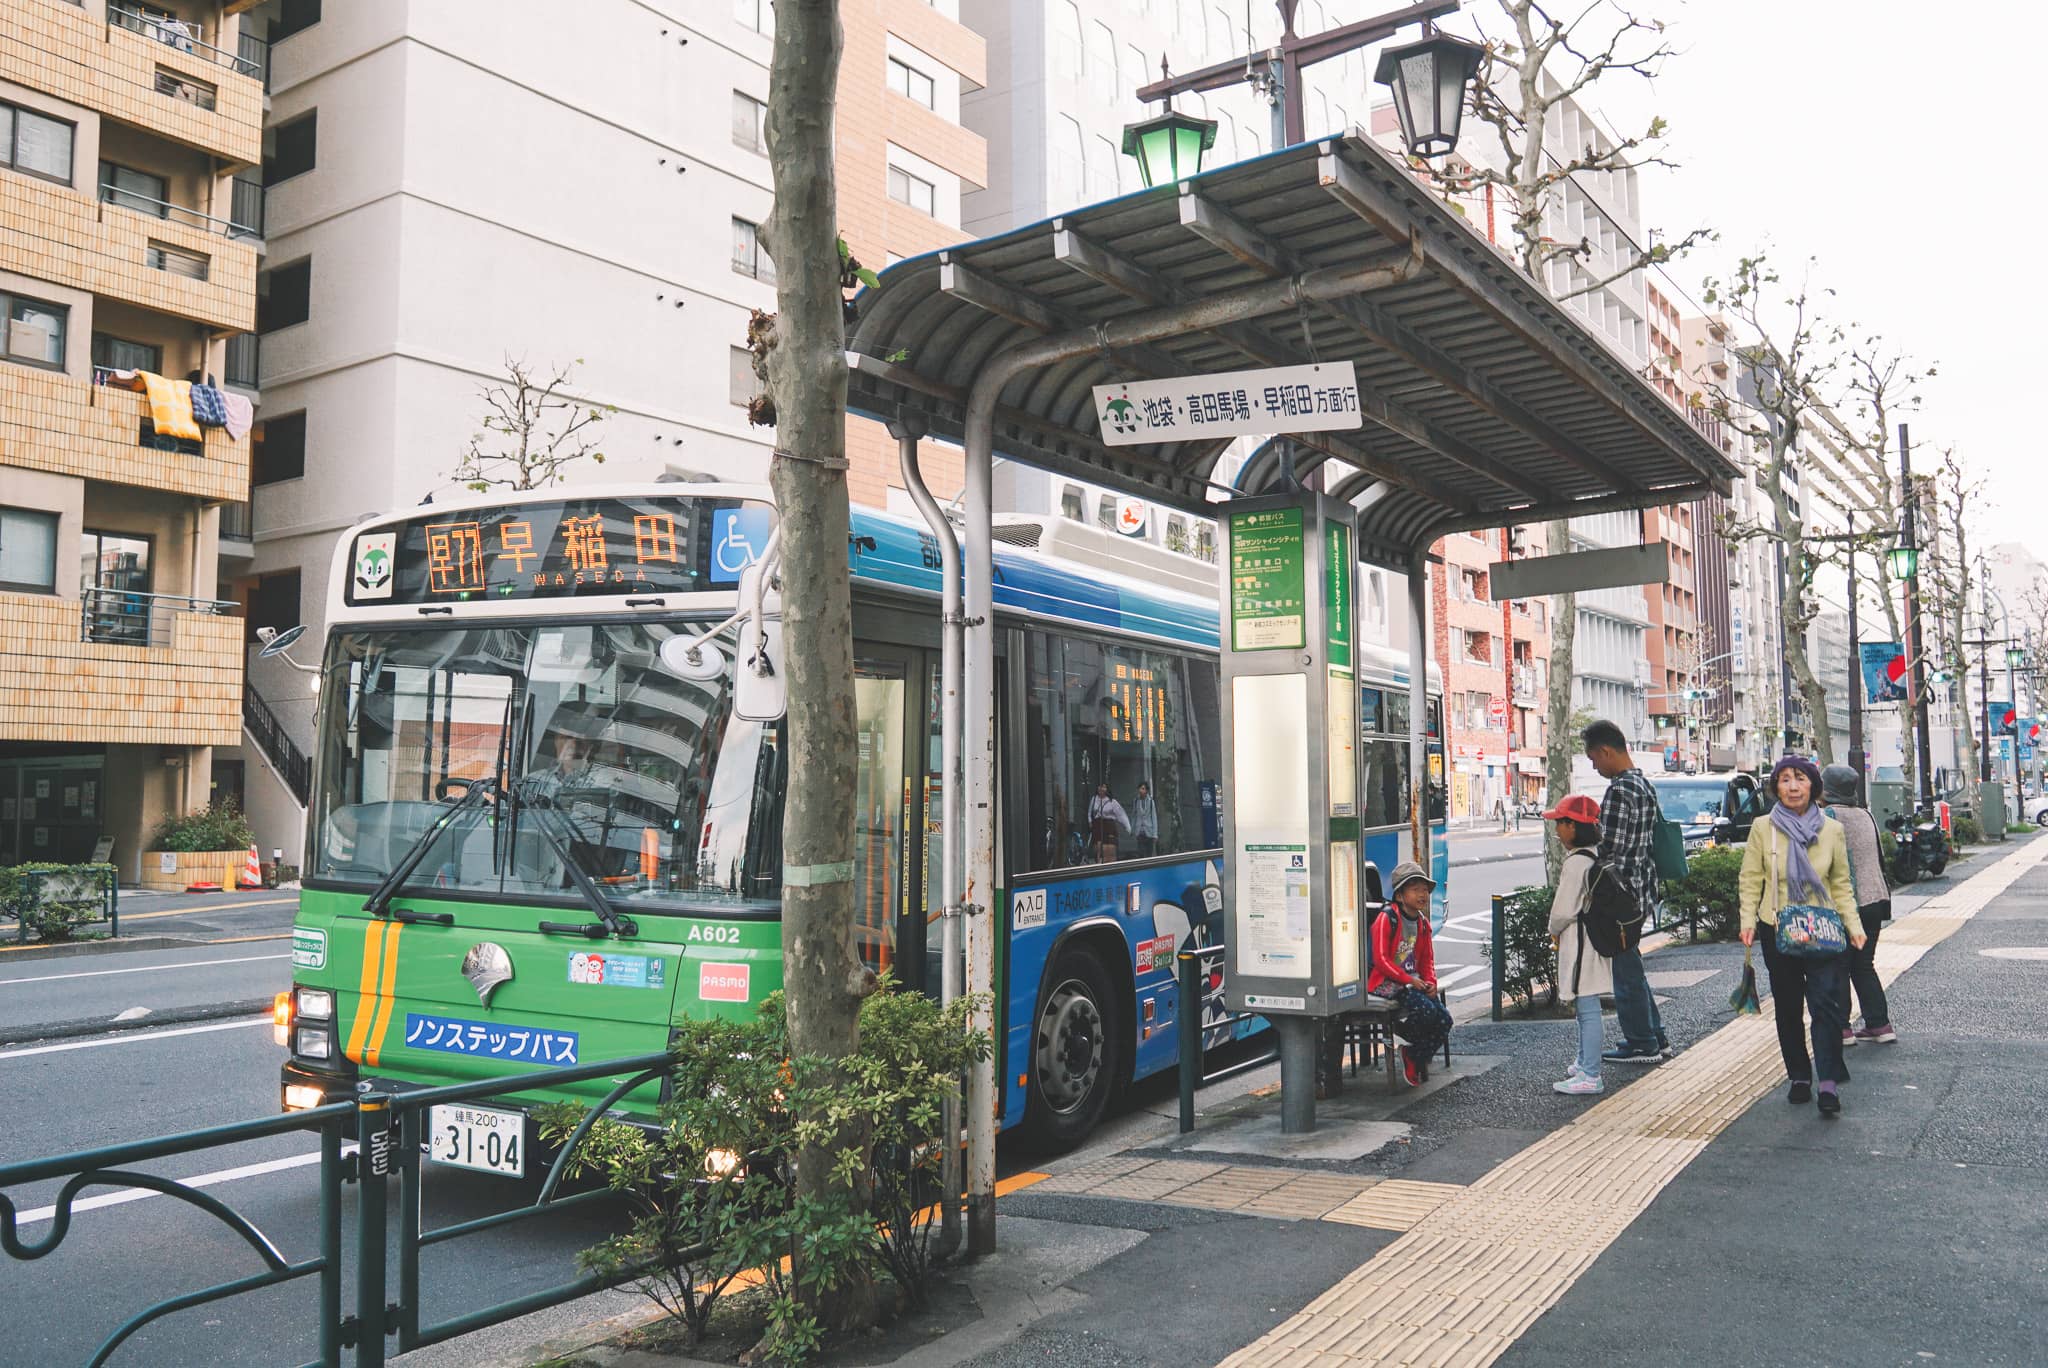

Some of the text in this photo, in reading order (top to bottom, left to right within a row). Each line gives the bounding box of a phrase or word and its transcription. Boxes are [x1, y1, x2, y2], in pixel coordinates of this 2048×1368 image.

[1143, 384, 1357, 428] 池袋・高田馬場・早稲田方面行
[431, 513, 677, 586] 早77 早稲田
[534, 569, 646, 586] WASEDA
[1026, 894, 1043, 912] 入口
[1053, 885, 1092, 914] T-A602
[1023, 912, 1045, 925] ENTRANCE
[688, 925, 740, 944] A602
[1154, 937, 1173, 951] PASMO
[702, 975, 747, 989] PASMO
[407, 1019, 577, 1064] ノンステップバス
[434, 1125, 519, 1171] か 31-04
